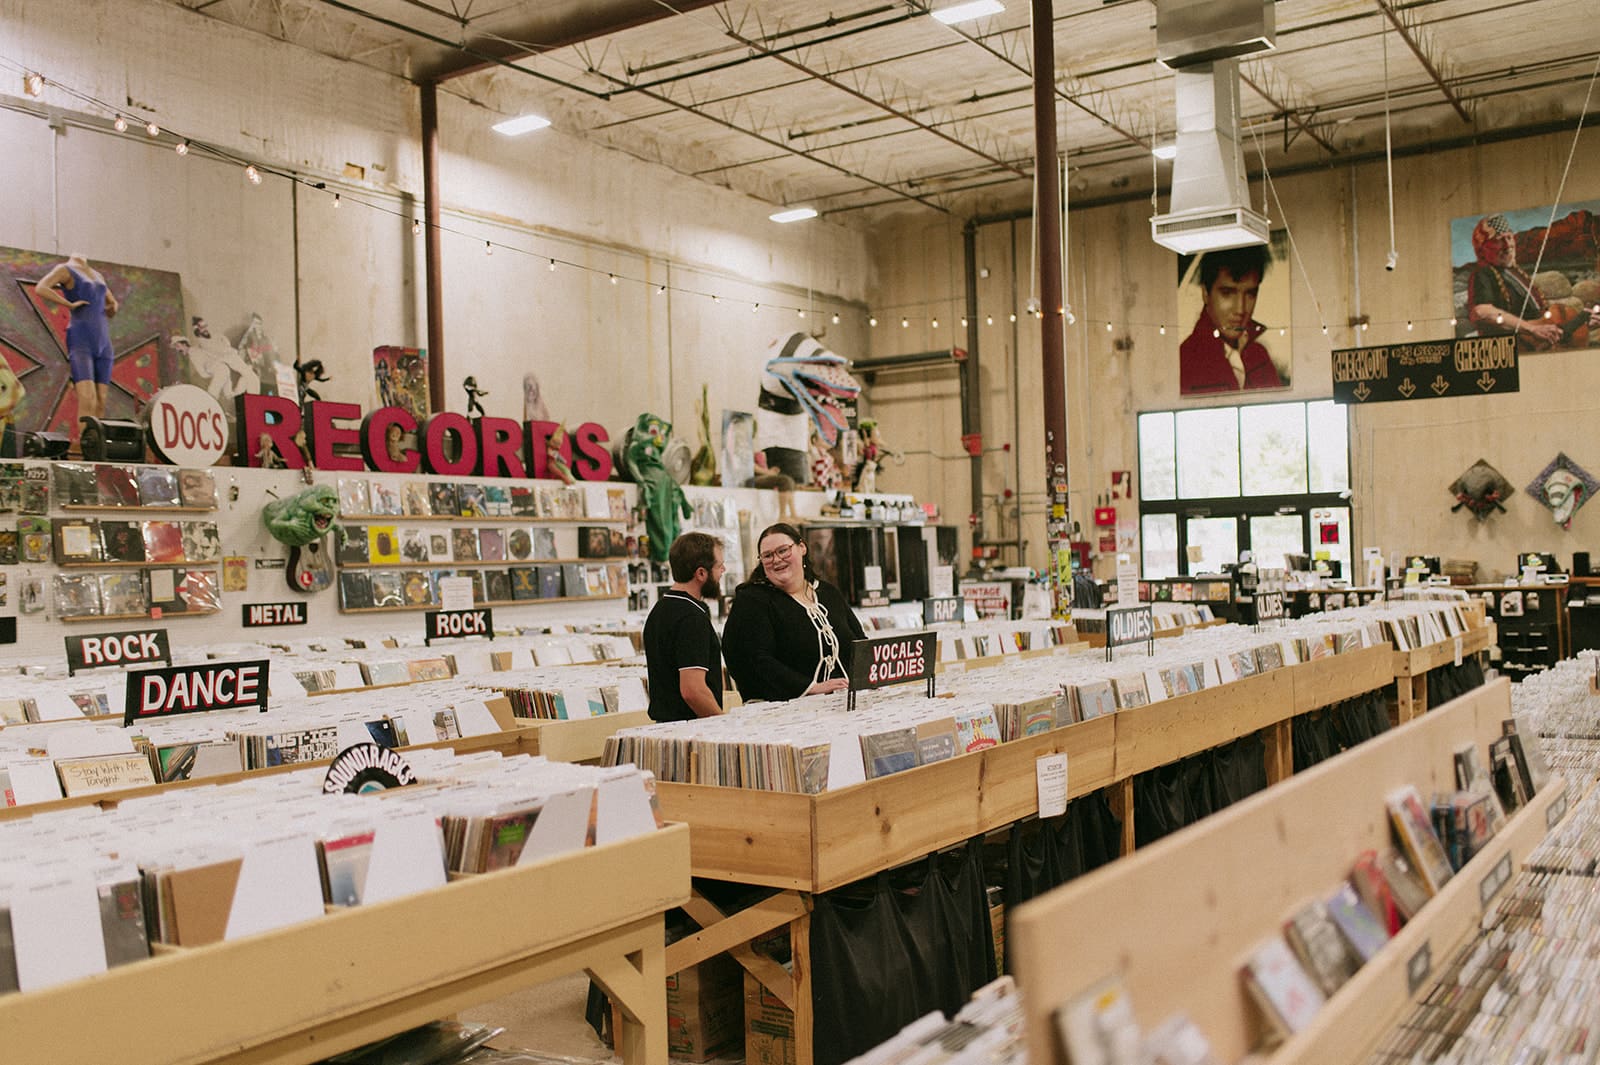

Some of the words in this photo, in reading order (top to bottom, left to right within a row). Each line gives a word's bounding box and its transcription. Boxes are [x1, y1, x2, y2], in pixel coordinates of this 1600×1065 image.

[1333, 348, 1388, 382] CHECKOUT
[1455, 336, 1516, 371] CHECKOUT
[161, 402, 224, 450] DOC'S
[241, 393, 612, 482] RECORDS
[962, 586, 1000, 597] VINTAGE
[1257, 593, 1283, 619] OLDIES
[250, 604, 303, 625] METAL
[436, 612, 487, 637] ROCK
[934, 600, 957, 621] RAP
[1113, 610, 1150, 642] OLDIES
[81, 632, 161, 664] ROCK
[873, 639, 924, 662] VOCALS
[140, 666, 261, 714] DANCE
[324, 744, 416, 796] SOUNDTRACKS
